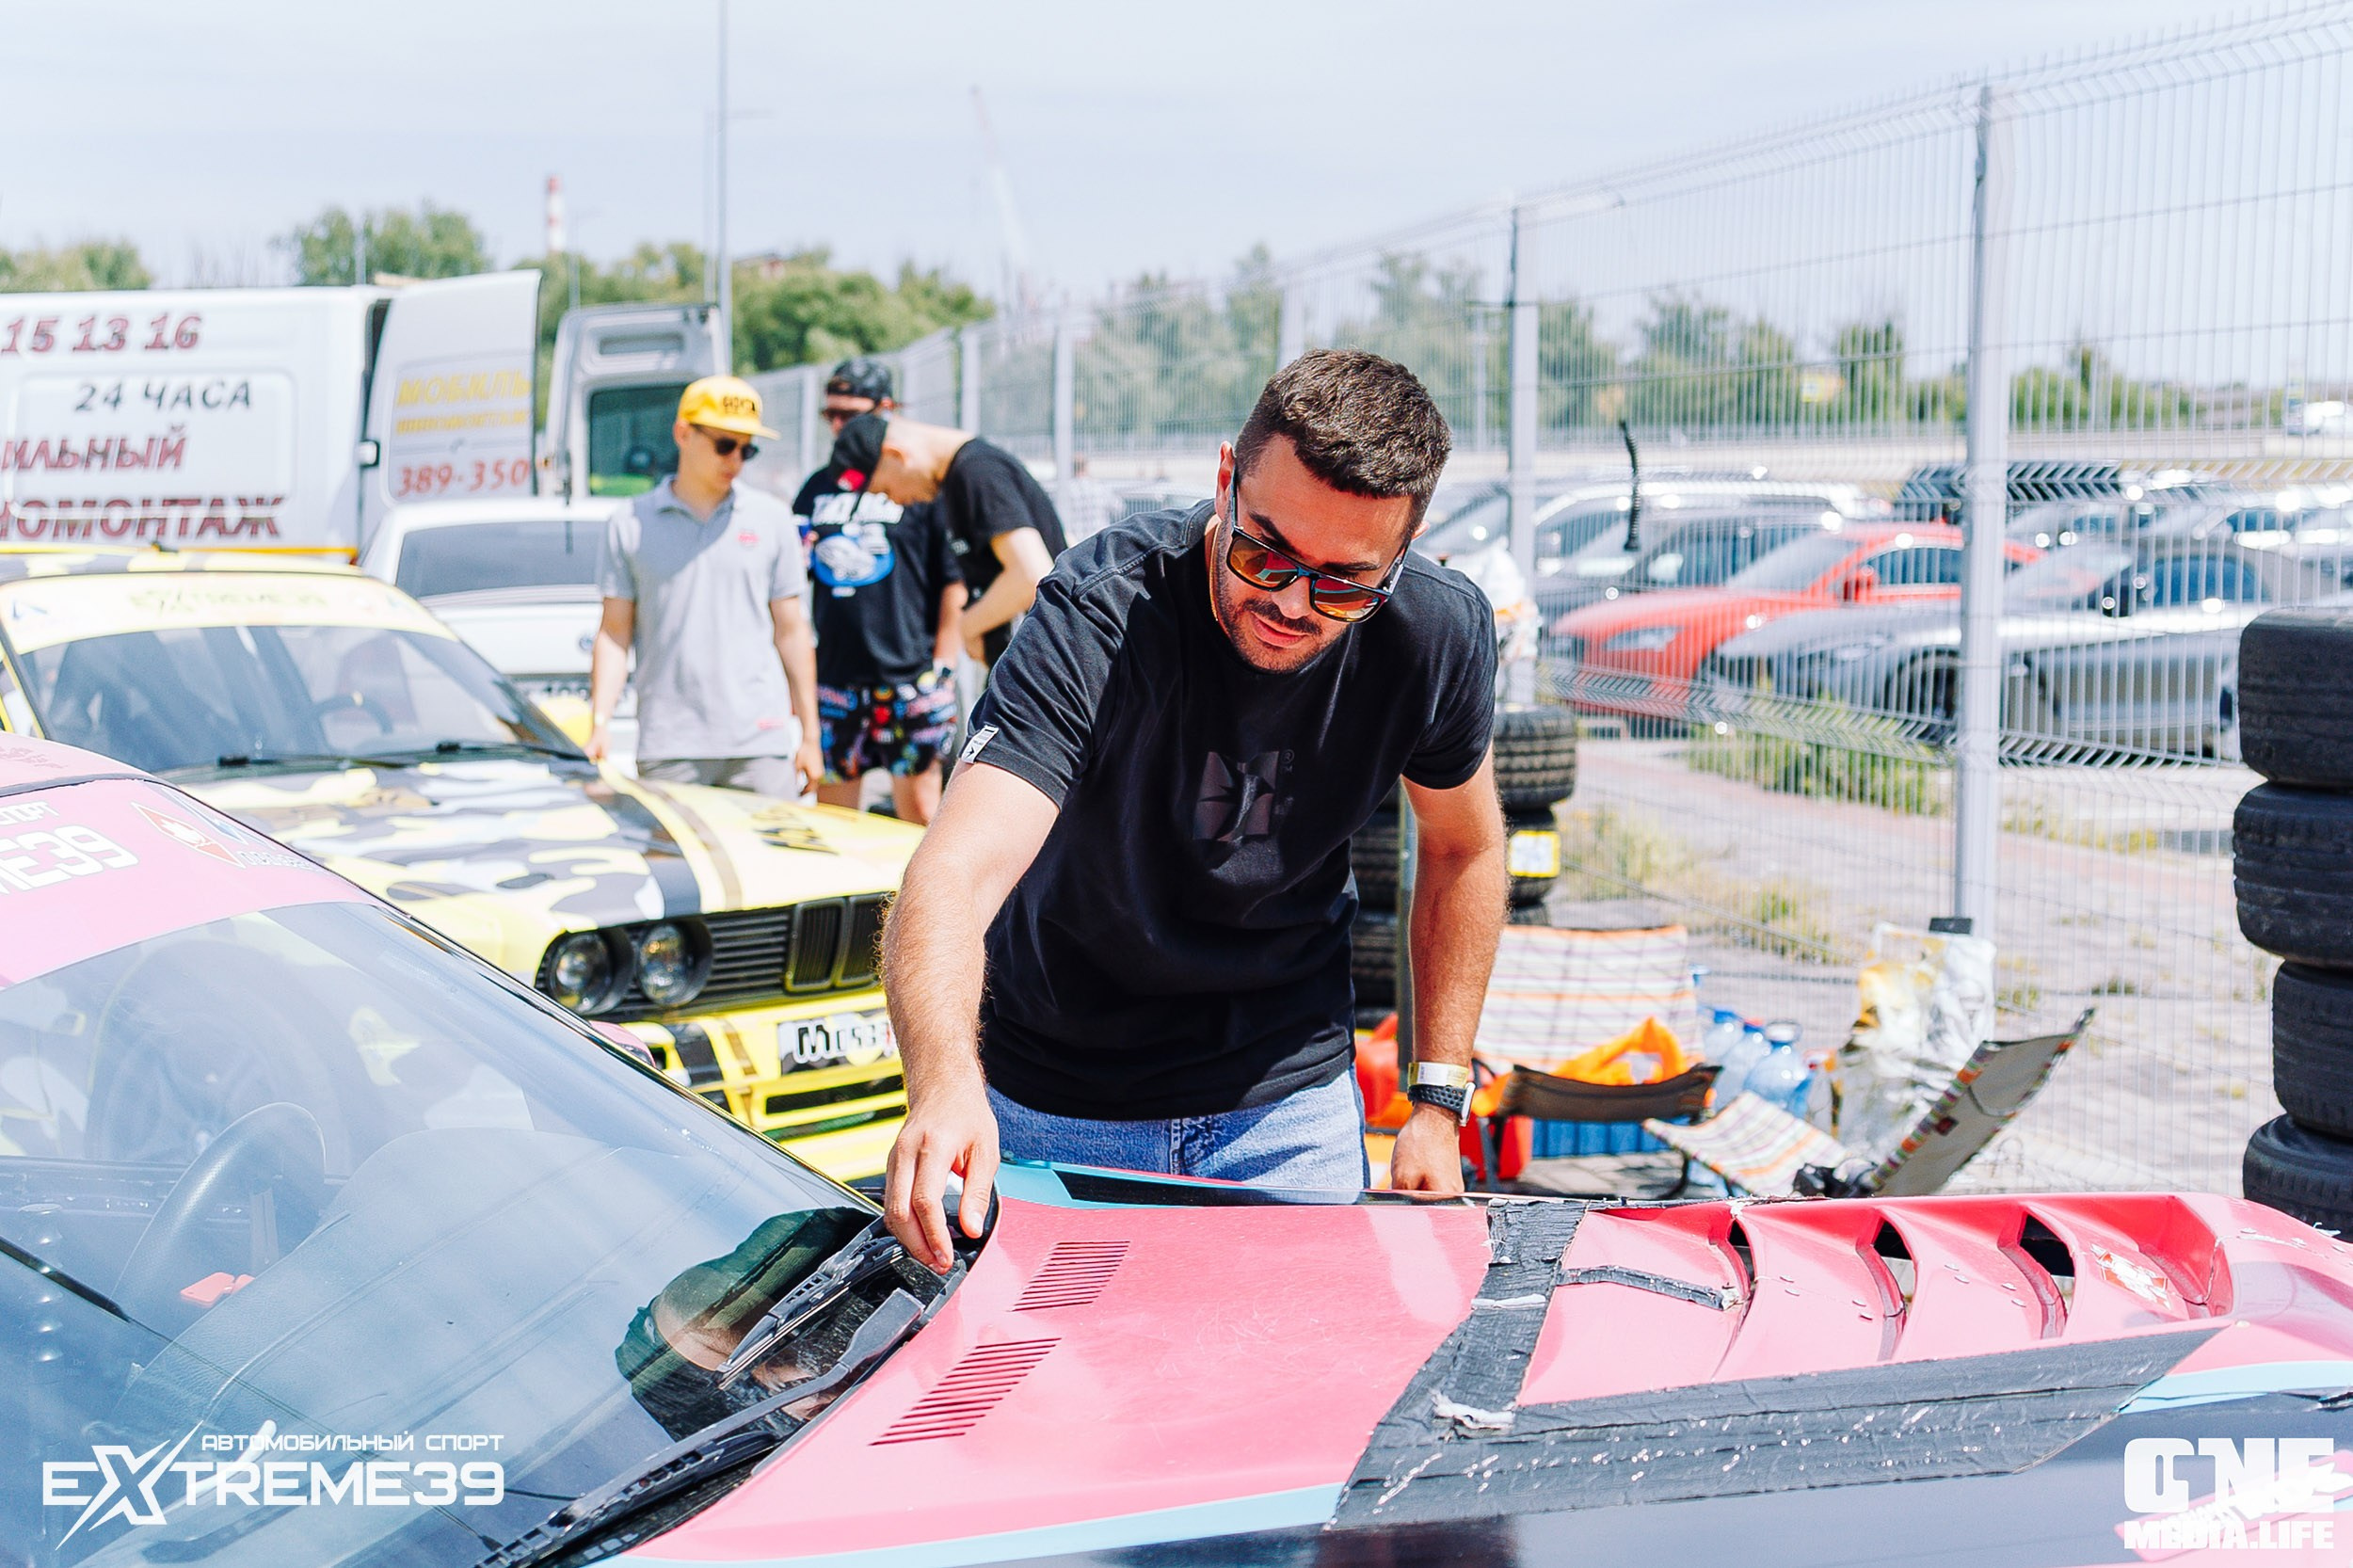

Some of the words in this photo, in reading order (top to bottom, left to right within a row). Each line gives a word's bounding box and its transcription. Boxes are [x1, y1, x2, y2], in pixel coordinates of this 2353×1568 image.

[2, 317, 58, 353] 15
[72, 315, 129, 353] 13
[144, 314, 203, 351] 16
[73, 381, 123, 412] 24
[143, 378, 252, 410] ЧАСА
[1, 424, 185, 470] ИЛЬНЫЙ
